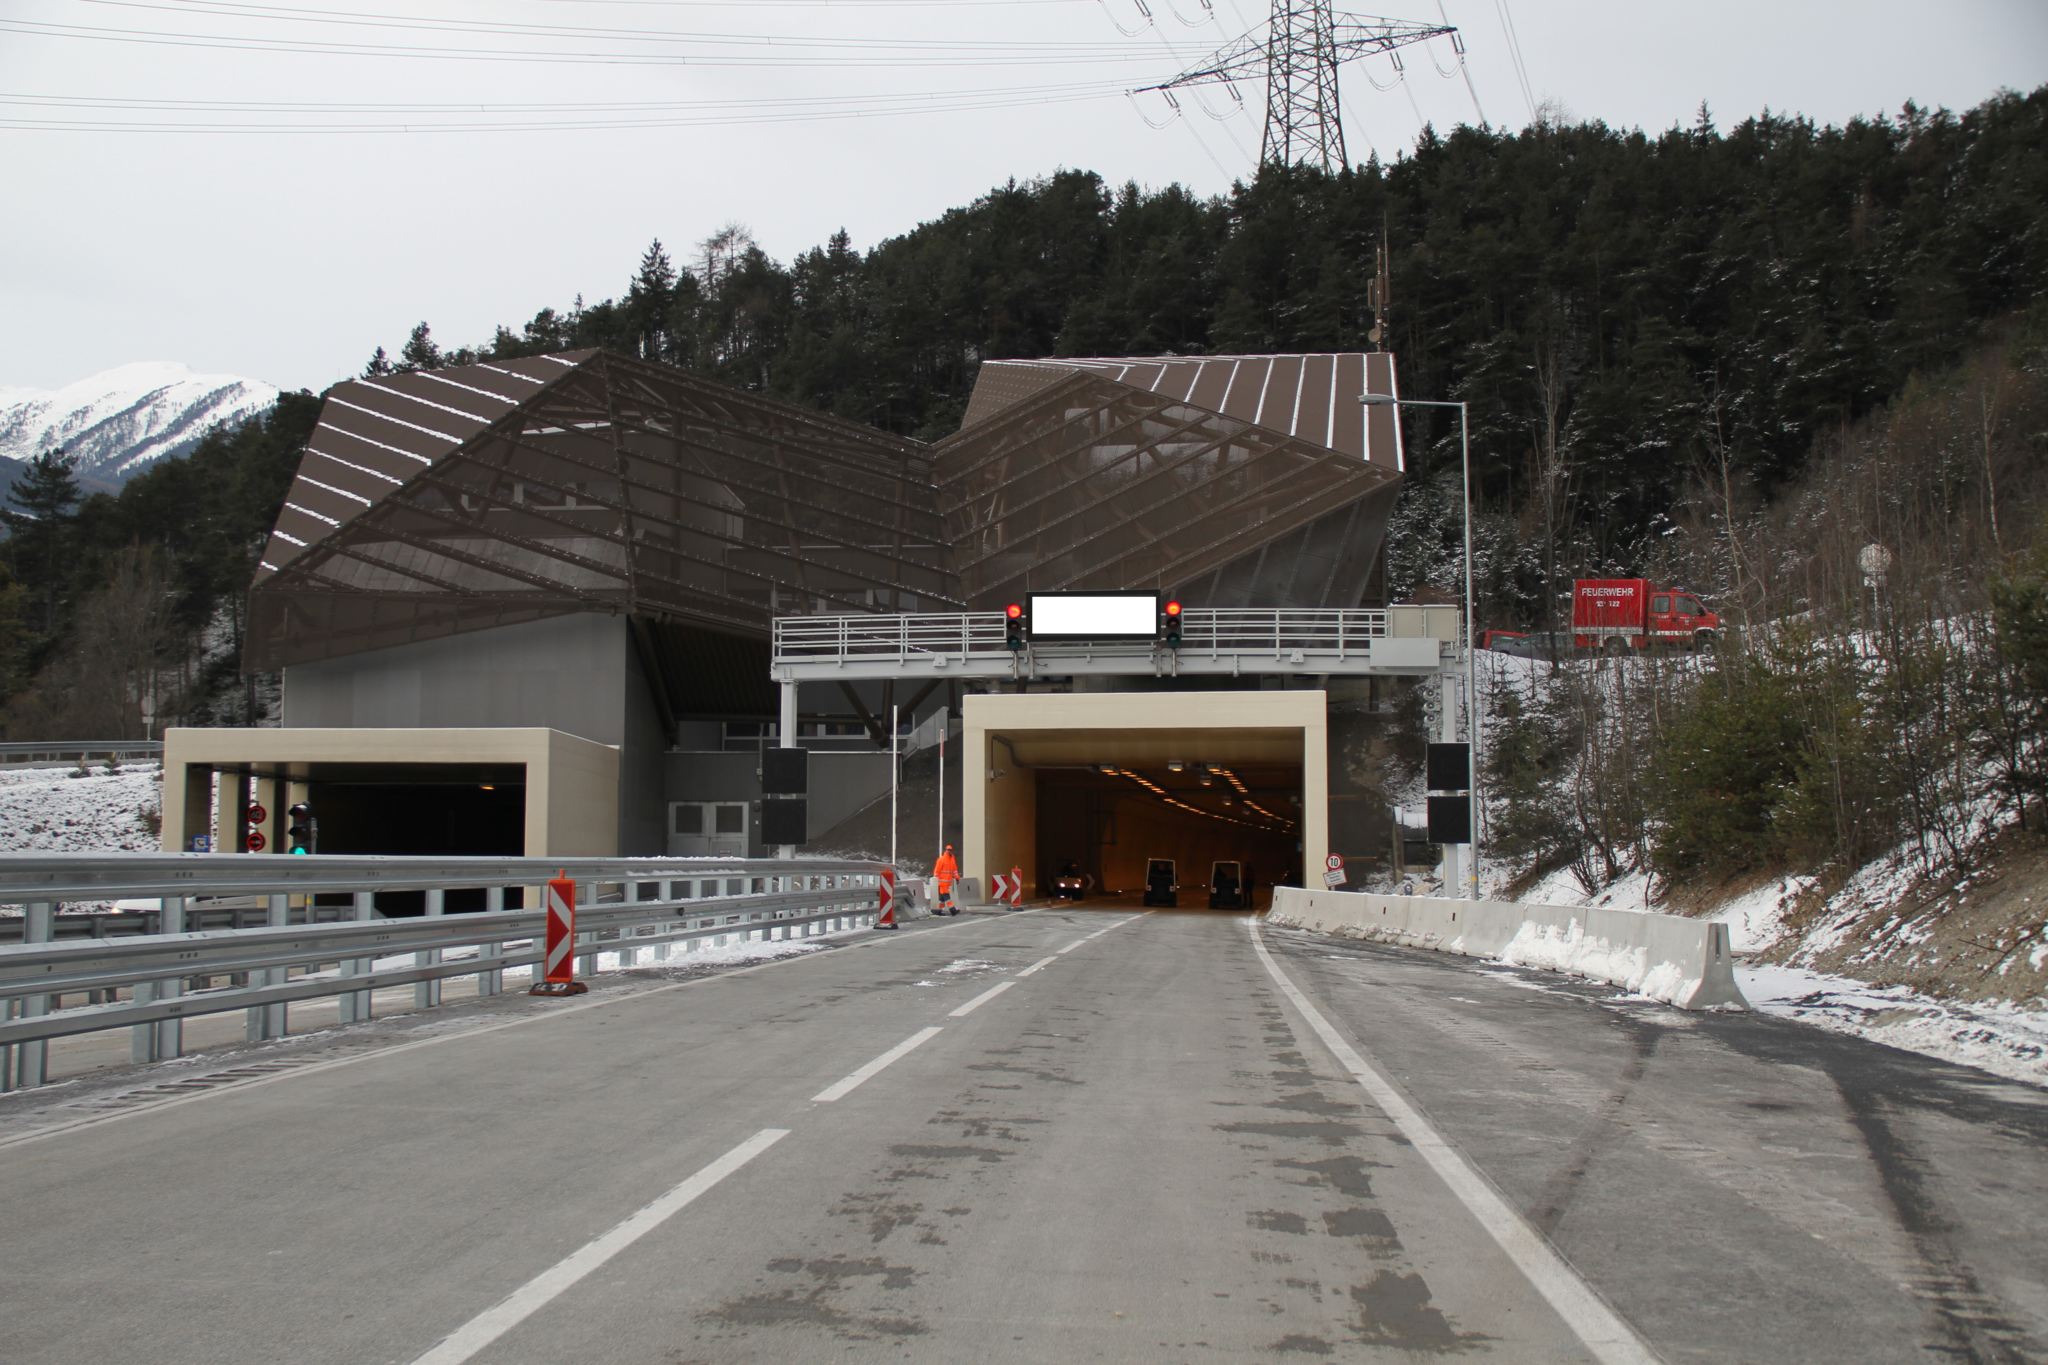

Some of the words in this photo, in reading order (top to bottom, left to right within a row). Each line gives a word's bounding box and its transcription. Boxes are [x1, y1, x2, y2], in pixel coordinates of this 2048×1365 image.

[1581, 587, 1634, 597] FEUERWEHR
[250, 810, 261, 819] 60
[1330, 857, 1339, 867] 10
